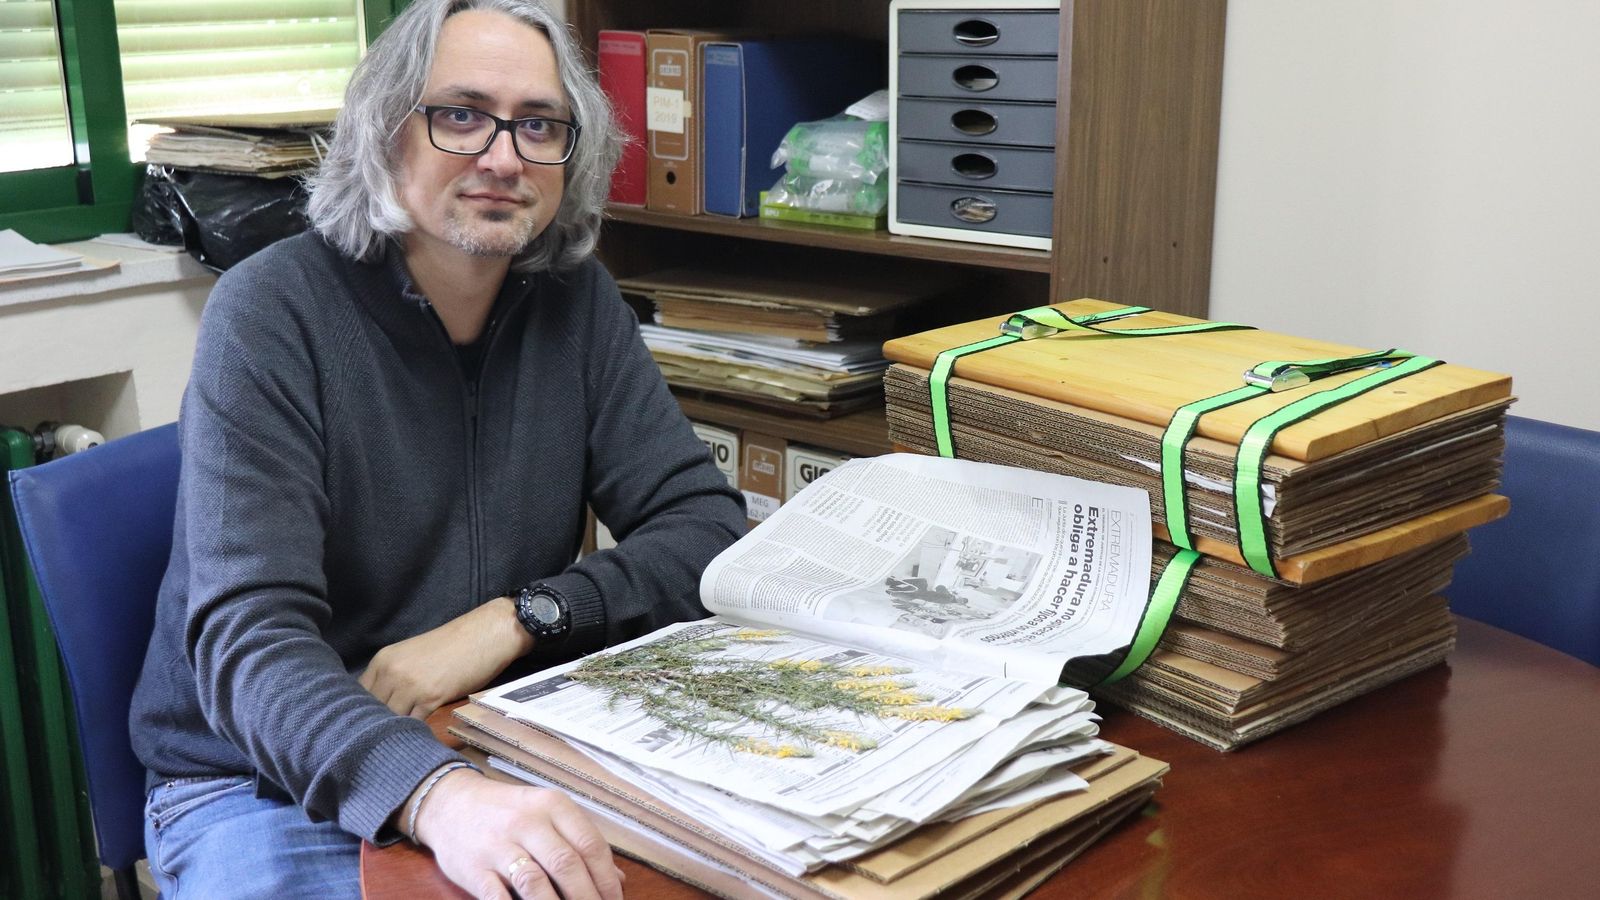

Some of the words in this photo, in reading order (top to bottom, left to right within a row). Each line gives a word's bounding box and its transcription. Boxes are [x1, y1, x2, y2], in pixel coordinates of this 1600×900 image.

[704, 440, 729, 463] IO
[752, 495, 769, 507] MEG
[1069, 503, 1085, 553] obliga
[1068, 557, 1078, 566] a
[1070, 506, 1099, 607] Extremadura
[1100, 510, 1122, 612] EXTREMADURA
[1050, 569, 1078, 609] hacer
[1062, 608, 1077, 621] no
